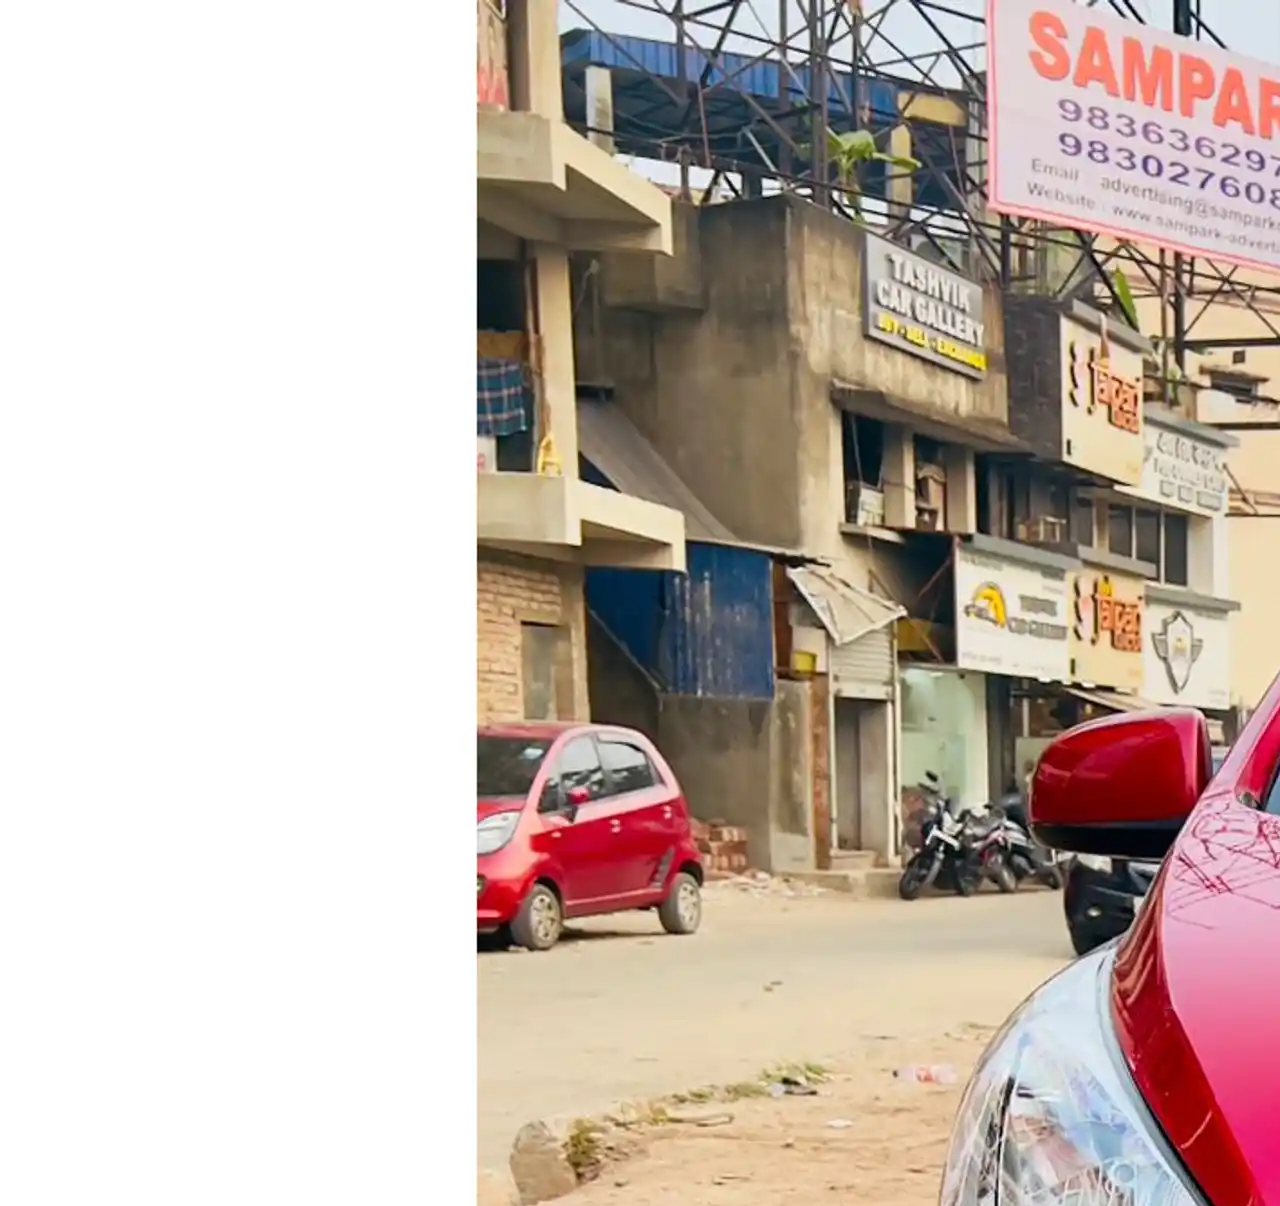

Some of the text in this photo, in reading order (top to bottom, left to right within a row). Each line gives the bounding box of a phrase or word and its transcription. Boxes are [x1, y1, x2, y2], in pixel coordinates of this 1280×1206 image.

[1031, 158, 1079, 182] Email
[876, 279, 985, 347] CAR GALLERY
[888, 252, 971, 314] TASHVIK
